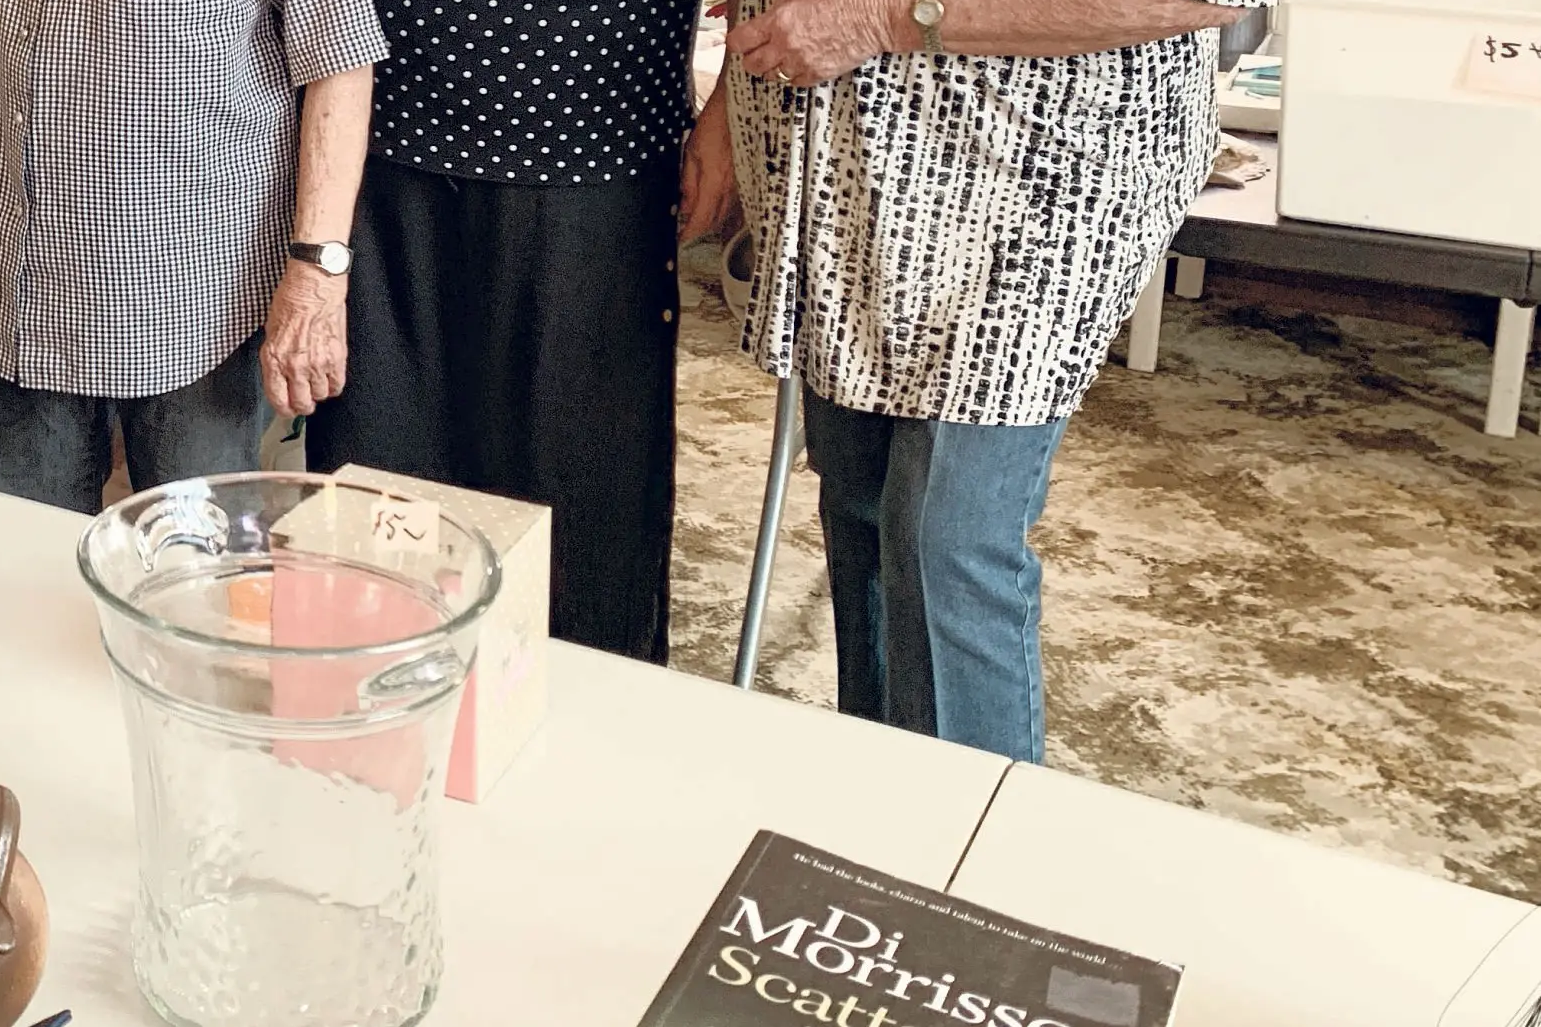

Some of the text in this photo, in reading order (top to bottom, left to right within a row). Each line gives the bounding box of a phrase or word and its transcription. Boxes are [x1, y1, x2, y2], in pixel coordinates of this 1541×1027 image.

[1483, 35, 1522, 63] $5
[812, 859, 835, 873] had
[835, 868, 854, 880] the
[889, 889, 926, 907] charm
[928, 903, 952, 915] and
[987, 922, 1001, 933] to
[1002, 927, 1028, 941] take
[1030, 937, 1046, 948] on
[1048, 942, 1069, 954] the
[814, 904, 905, 963] Di
[709, 945, 915, 1027] Scatt
